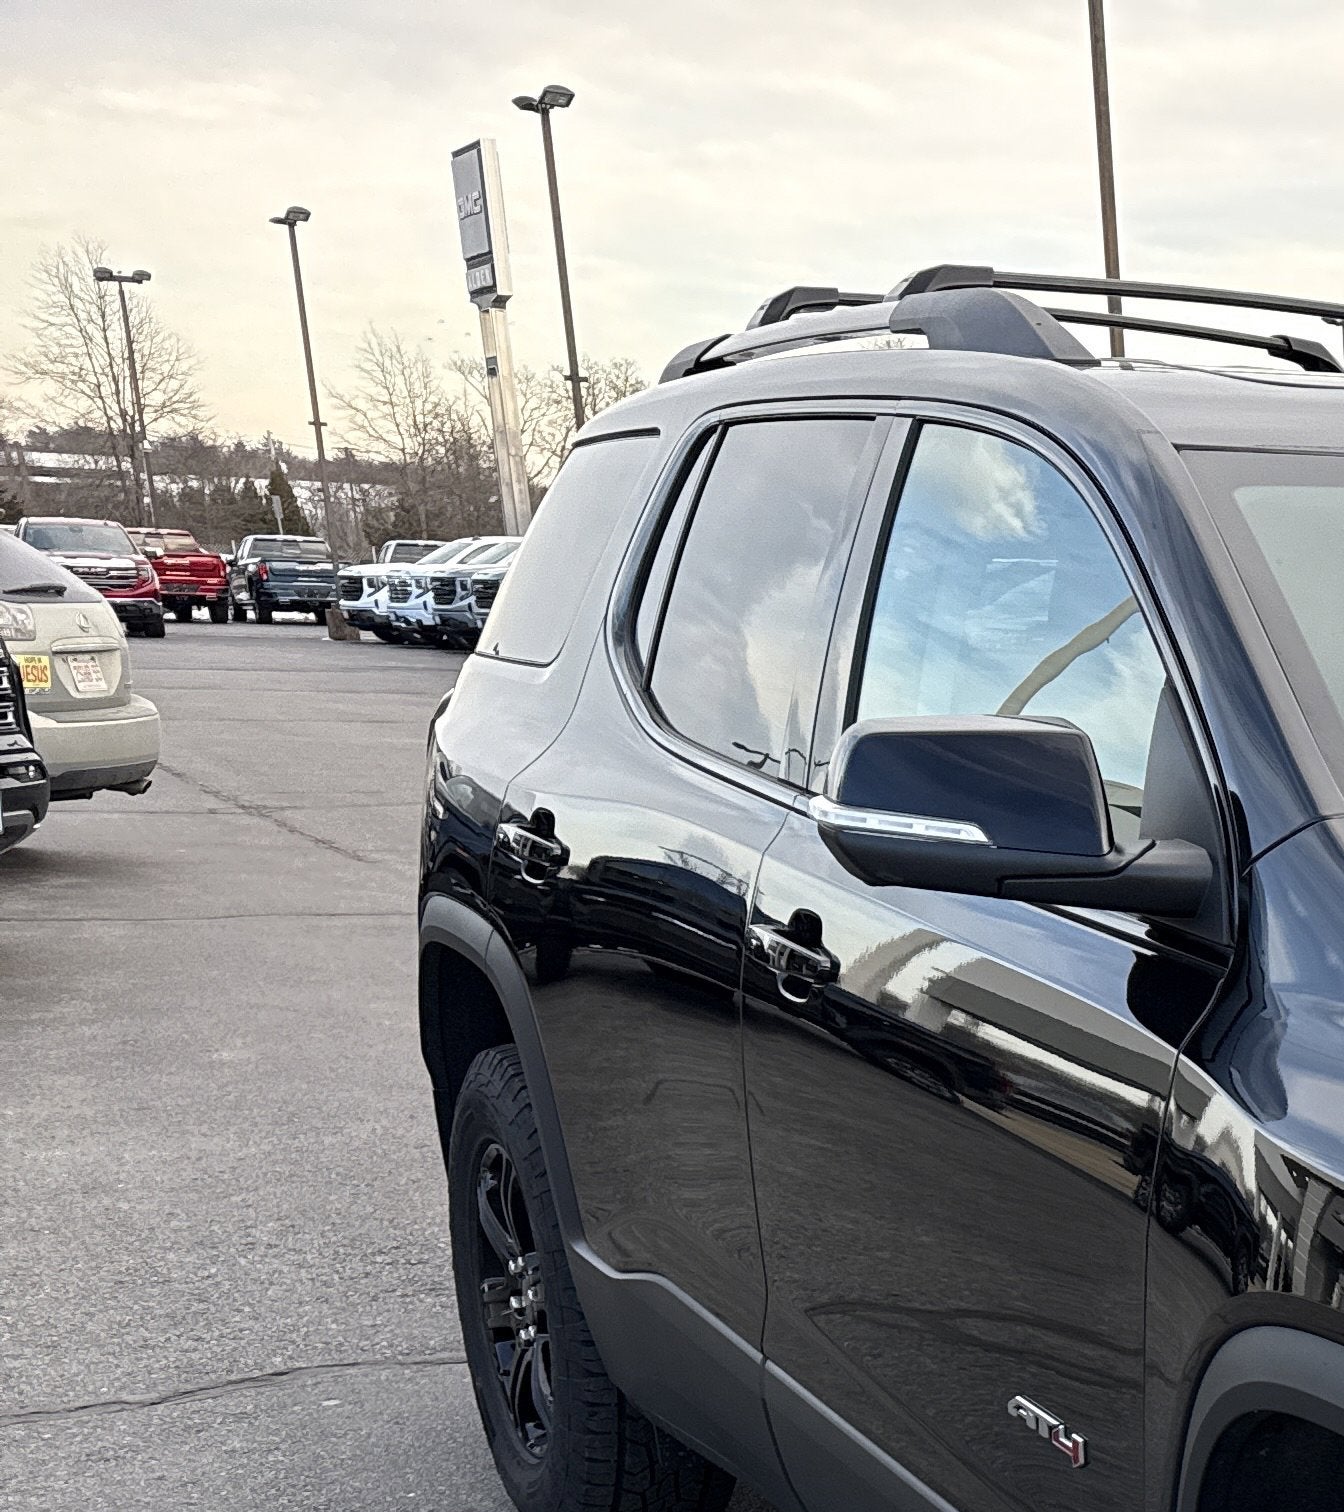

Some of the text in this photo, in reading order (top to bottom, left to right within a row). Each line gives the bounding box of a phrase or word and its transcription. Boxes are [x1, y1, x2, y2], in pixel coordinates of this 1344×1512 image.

[457, 190, 482, 220] GMC
[21, 664, 48, 683] JESUS
[1008, 1395, 1085, 1468] AT4
